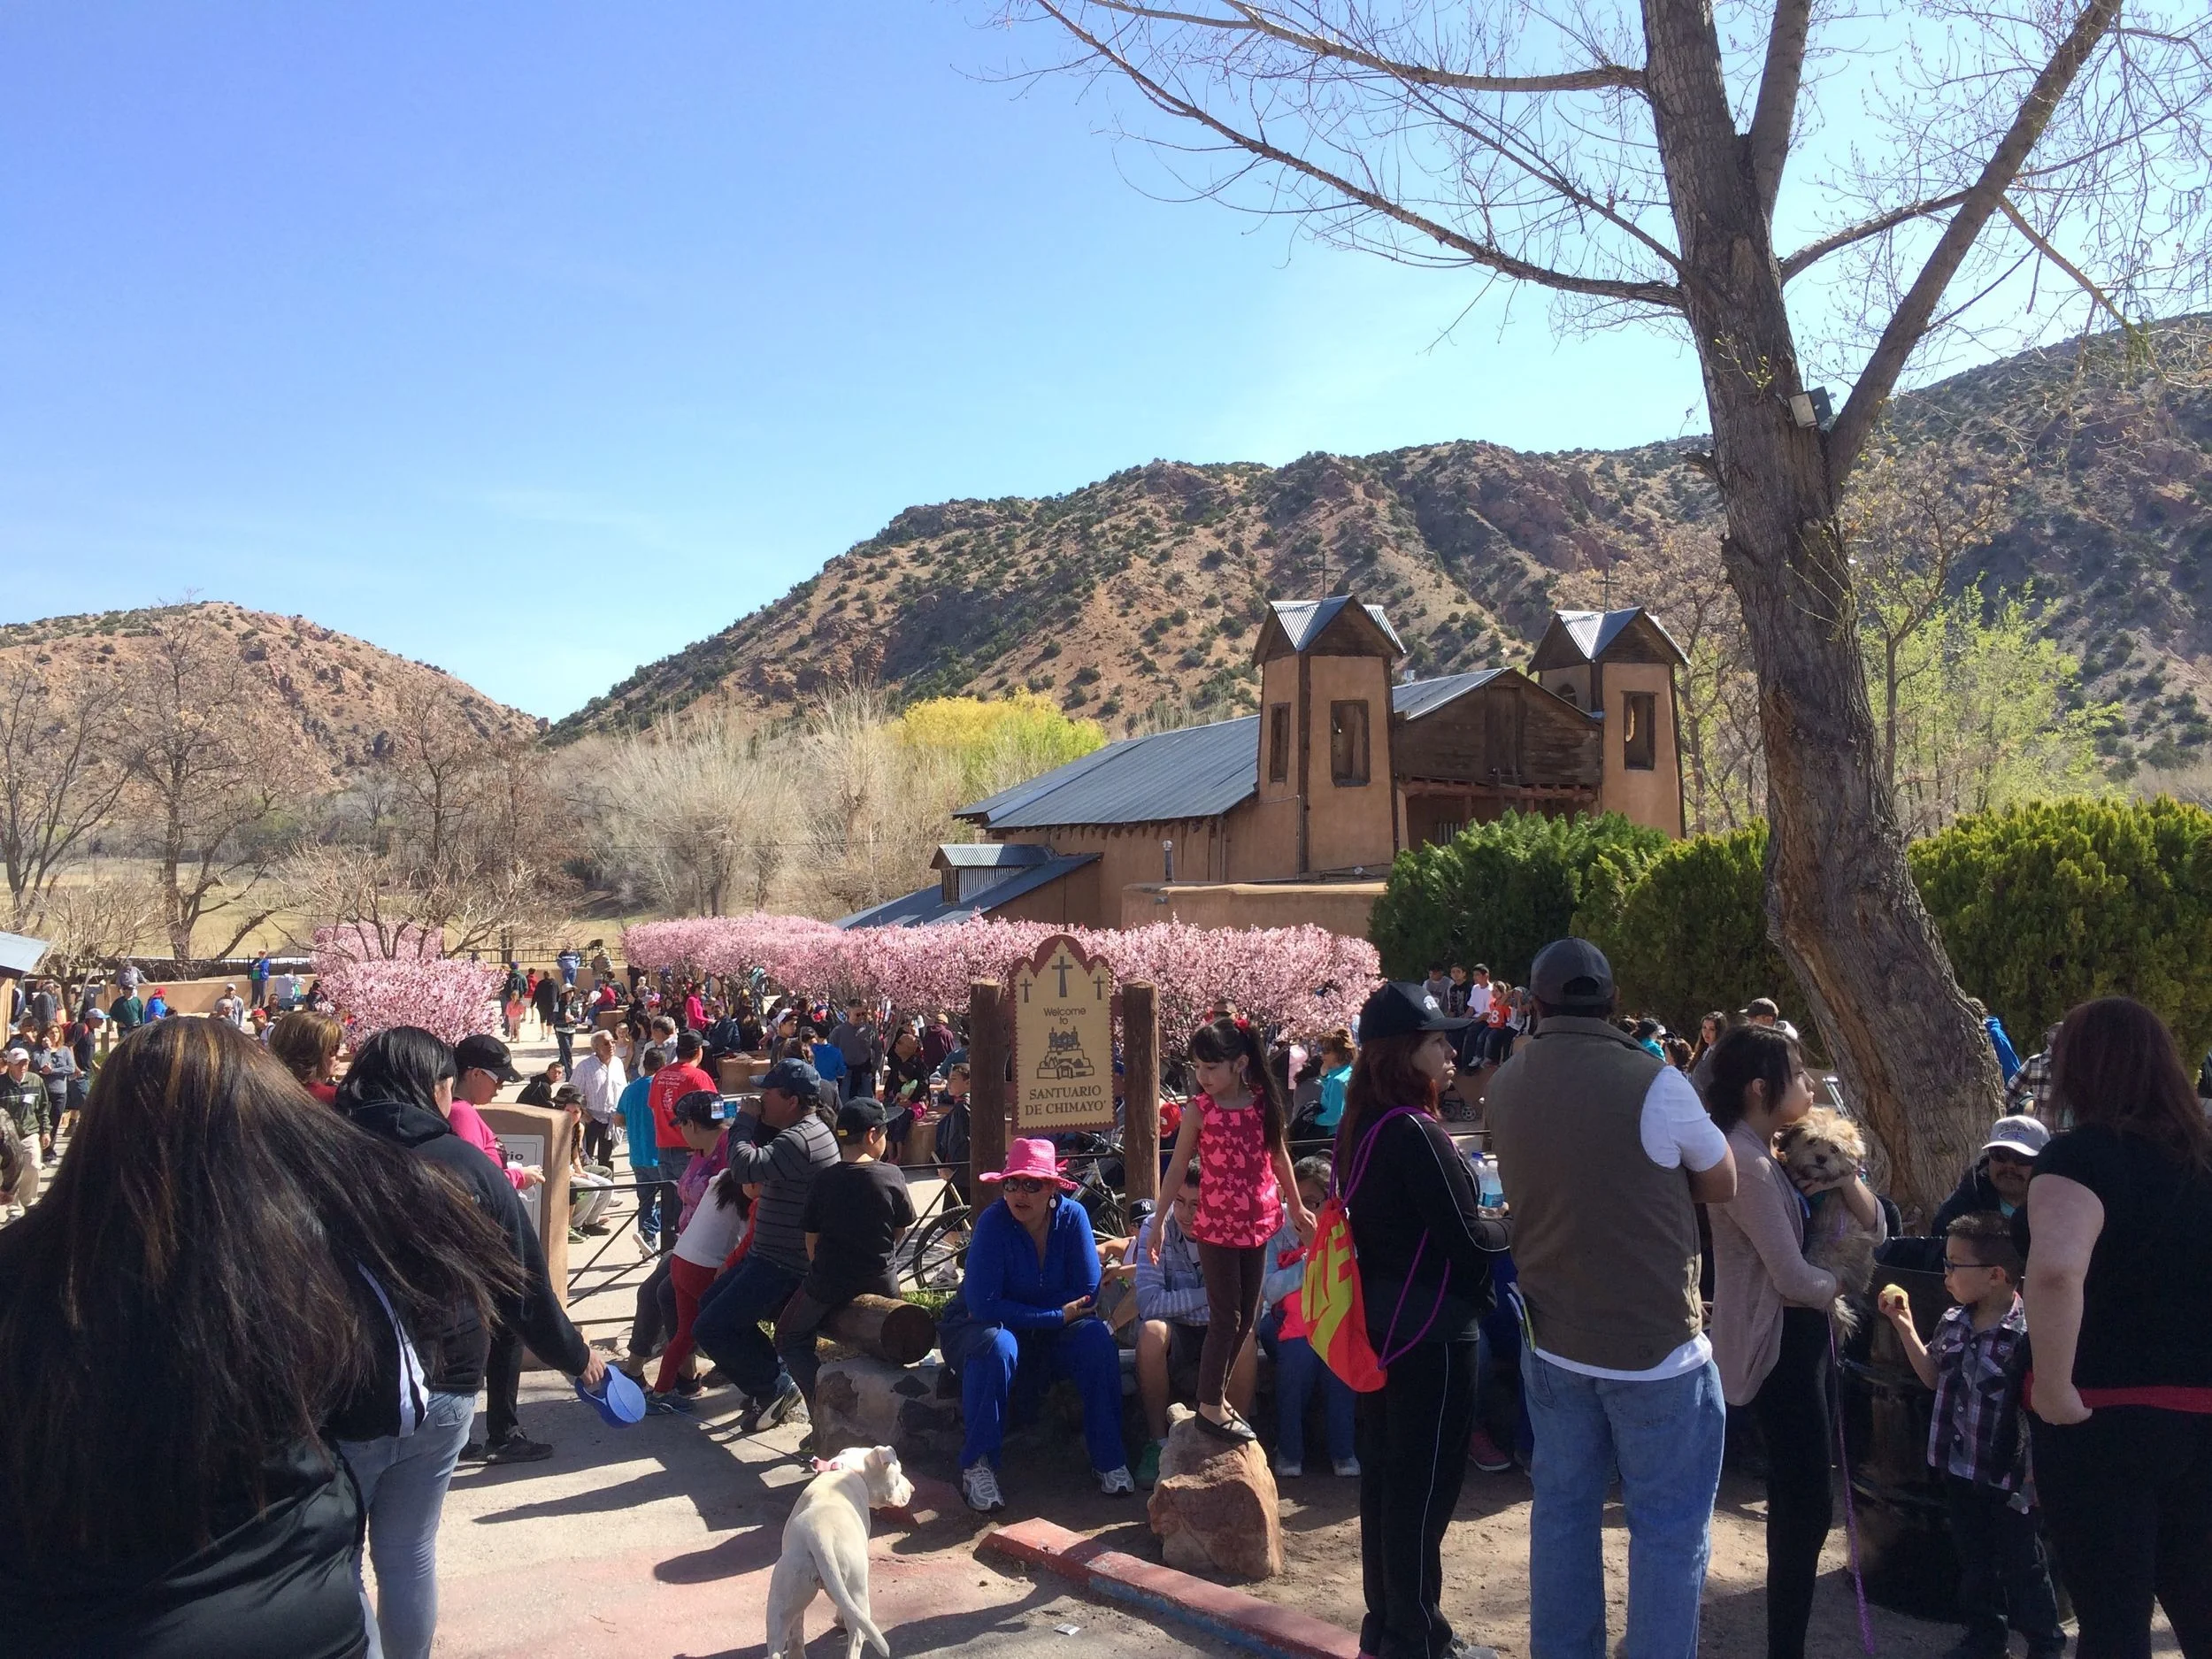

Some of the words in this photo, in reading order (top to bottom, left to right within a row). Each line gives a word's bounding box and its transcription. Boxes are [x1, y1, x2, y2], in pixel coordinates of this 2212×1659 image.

[1042, 1007, 1087, 1018] Welcome
[1059, 1017, 1069, 1025] to
[1028, 1084, 1102, 1101] SANTUARIO
[1025, 1103, 1043, 1116] DE
